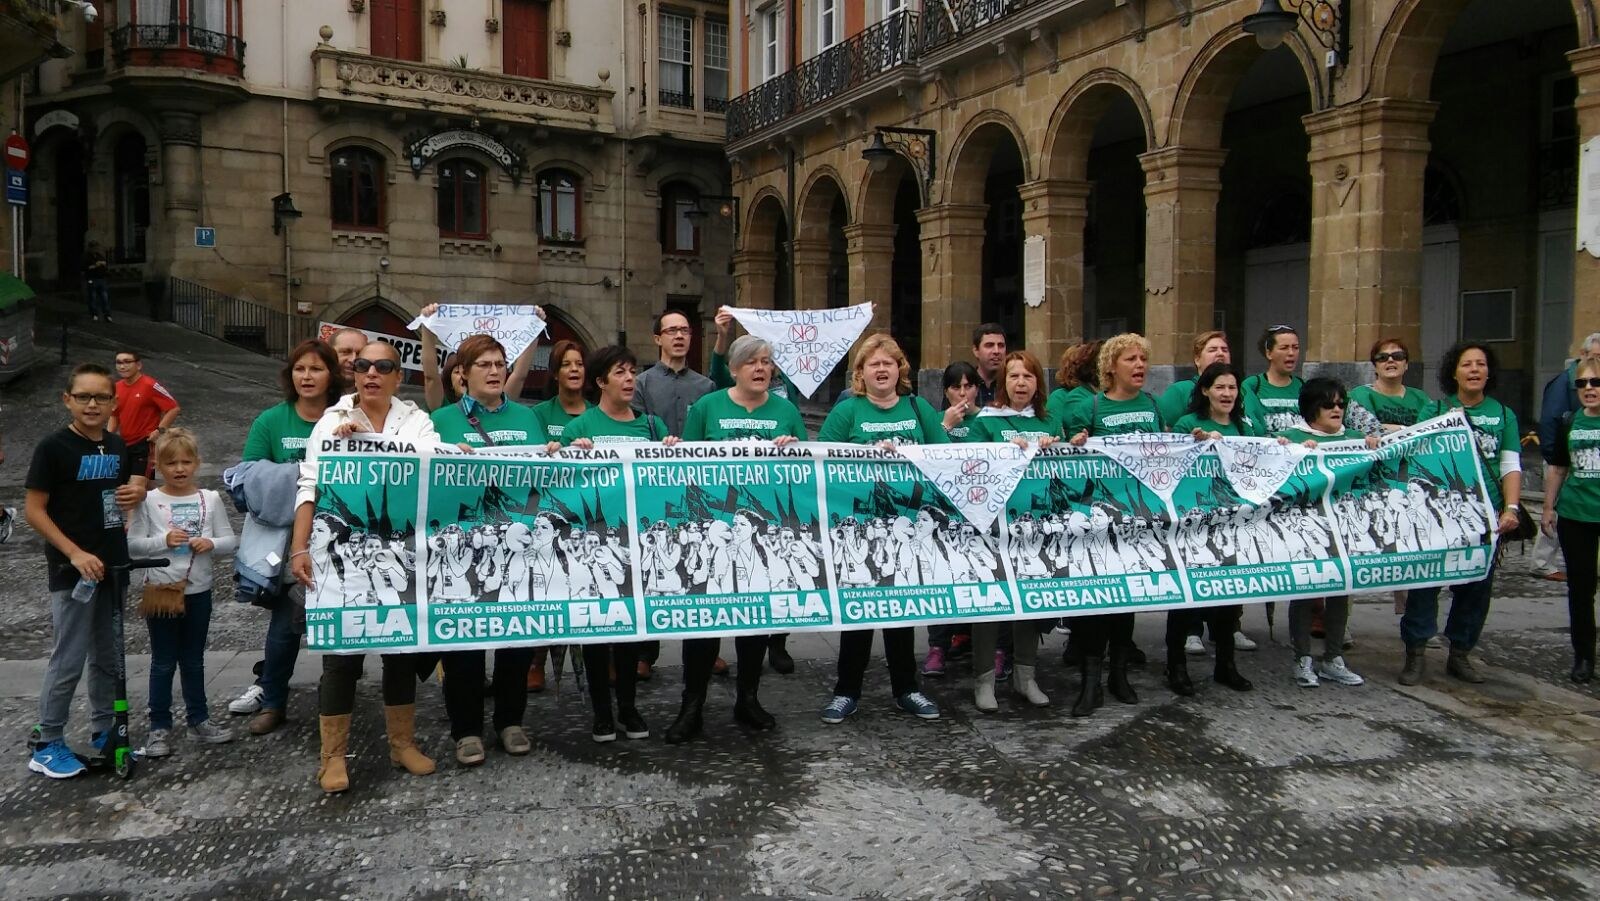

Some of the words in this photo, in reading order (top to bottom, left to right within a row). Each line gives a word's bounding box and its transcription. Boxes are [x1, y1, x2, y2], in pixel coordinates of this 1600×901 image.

[201, 230, 210, 240] P
[437, 304, 537, 318] RESIDENCI
[753, 306, 866, 325] RESIDENCIA
[791, 325, 817, 342] NO
[778, 342, 838, 354] DESPIDOS
[799, 354, 819, 372] NO
[812, 337, 852, 383] GURENA
[322, 440, 340, 452] DE
[347, 440, 416, 453] BIZKAIA
[1435, 433, 1468, 454] STOP
[561, 449, 620, 460] BIZKAIA
[635, 447, 727, 459] RESIDENCIAS
[732, 447, 749, 457] DE
[754, 446, 813, 457] BIZKAIA
[923, 447, 1028, 460] RESIDENCIA
[76, 454, 121, 481] NIKE
[368, 461, 415, 486] STOP
[637, 464, 769, 486] PREKARIETATEARI
[773, 464, 812, 484] STOP
[434, 463, 576, 489] PREKARIETATEARI
[581, 466, 620, 489] STOP
[954, 475, 1001, 486] DESPIDOS
[1150, 471, 1170, 486] NO
[987, 467, 1022, 513] GURENA
[1354, 557, 1388, 566] BIZKAIKO
[1356, 562, 1441, 585] GREBAN!!
[1444, 548, 1486, 572] ELA
[1191, 570, 1227, 578] BIZKAIKO
[1229, 565, 1288, 575] ERRESIDENTZIAK
[1195, 574, 1292, 597] GREBAN!!
[1291, 561, 1343, 585] ELA
[1022, 581, 1058, 590] BIZKAIKO
[1061, 577, 1122, 587] ERRESIDENTZIAK
[1025, 586, 1128, 609] GREBAN!!
[1125, 574, 1181, 597] ELA
[650, 598, 692, 606] BIZKAIKO
[696, 596, 764, 605] ERRESIDENTZIAK
[843, 590, 882, 599] BIZKAIKO
[885, 587, 948, 597] ERRESIDENTZIAK
[434, 606, 482, 615] BIZKAIKO
[485, 603, 563, 614] ERRESIDENTZIAK
[845, 597, 953, 620] GREBAN!!
[953, 585, 1010, 608] ELA
[651, 606, 767, 630] GREBAN!!
[769, 593, 829, 618] ELA
[342, 608, 413, 638] ELA
[435, 614, 565, 640] GREBAN!!
[569, 600, 633, 627] ELA
[595, 625, 634, 633] SINDIKATUA
[342, 637, 368, 645] EUSKAL
[370, 636, 414, 644] SINDIKATUA
